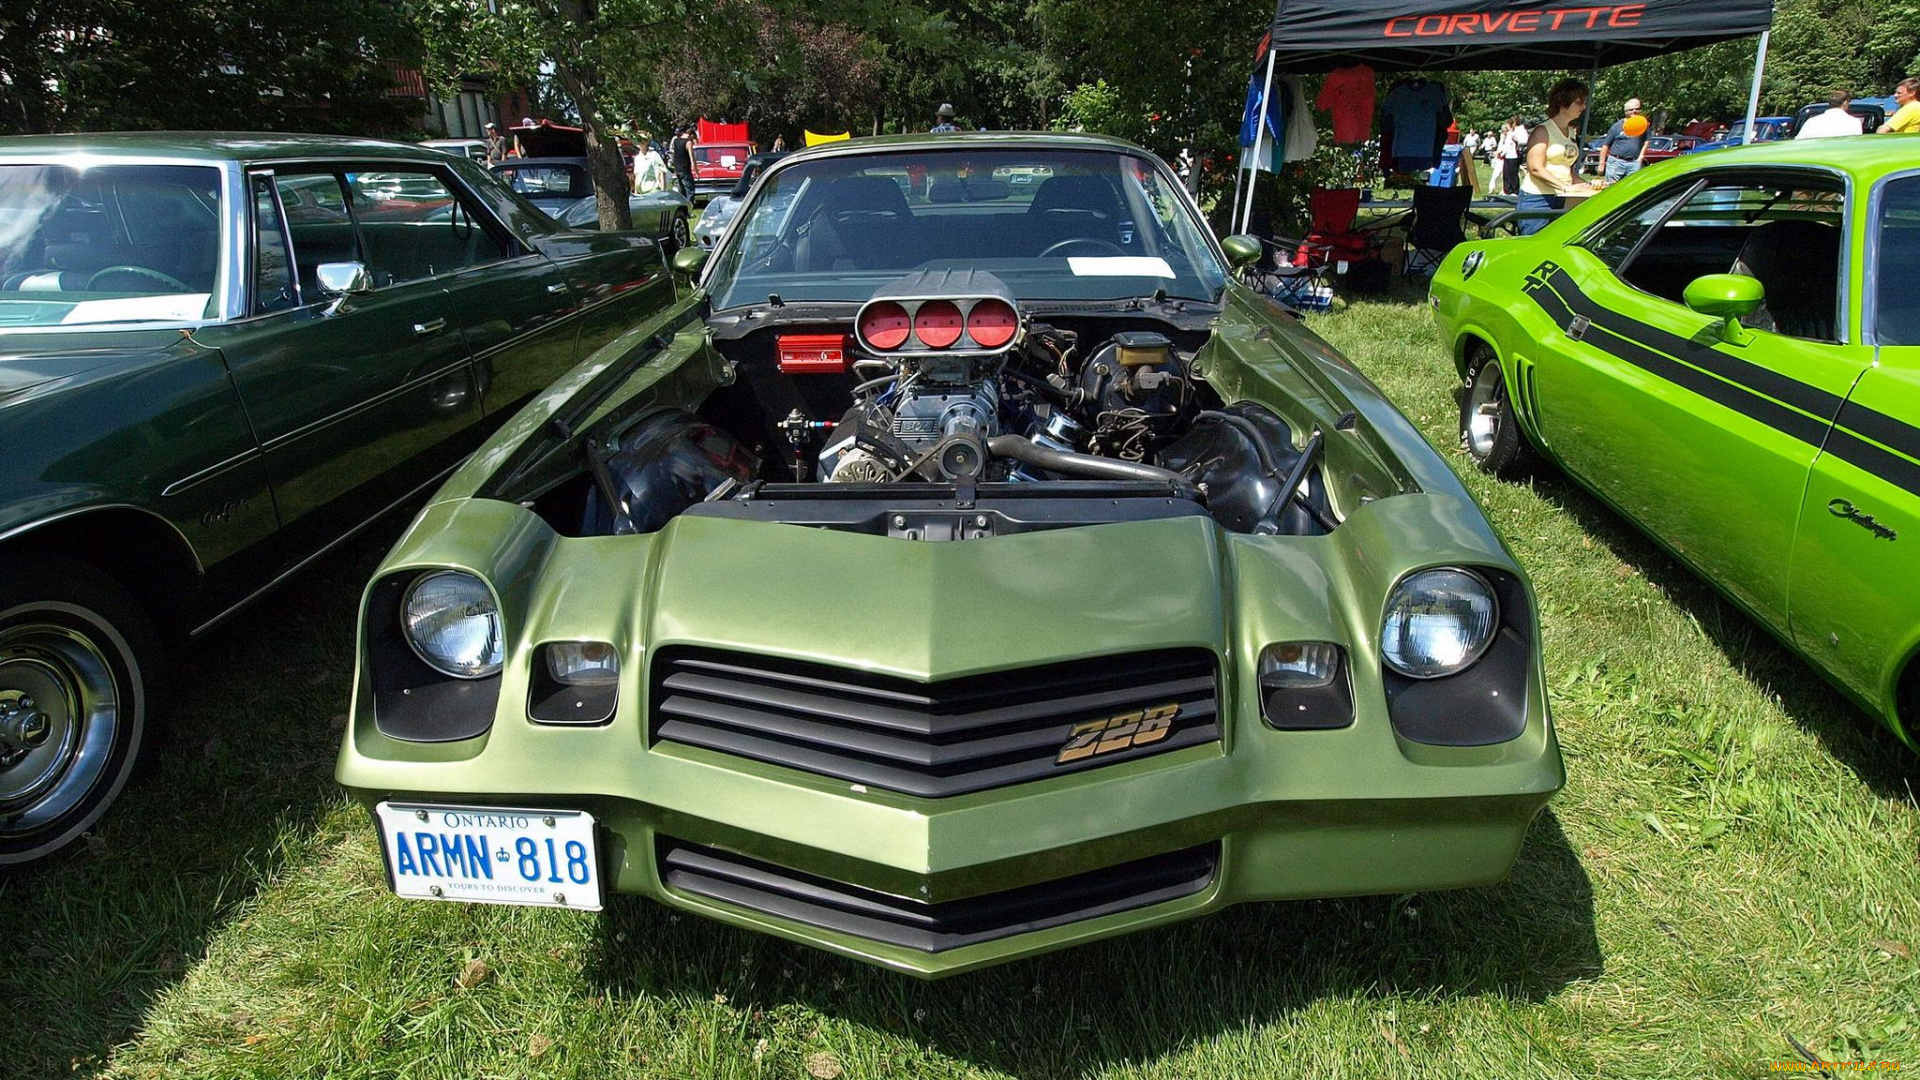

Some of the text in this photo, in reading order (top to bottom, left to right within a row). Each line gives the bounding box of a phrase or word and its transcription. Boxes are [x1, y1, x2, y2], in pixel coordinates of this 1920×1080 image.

[1384, 4, 1647, 37] CORVETTE
[1057, 704, 1180, 763] Z28
[396, 831, 590, 885] ARMN 818
[447, 882, 546, 894] YOURS TO DISCOVER
